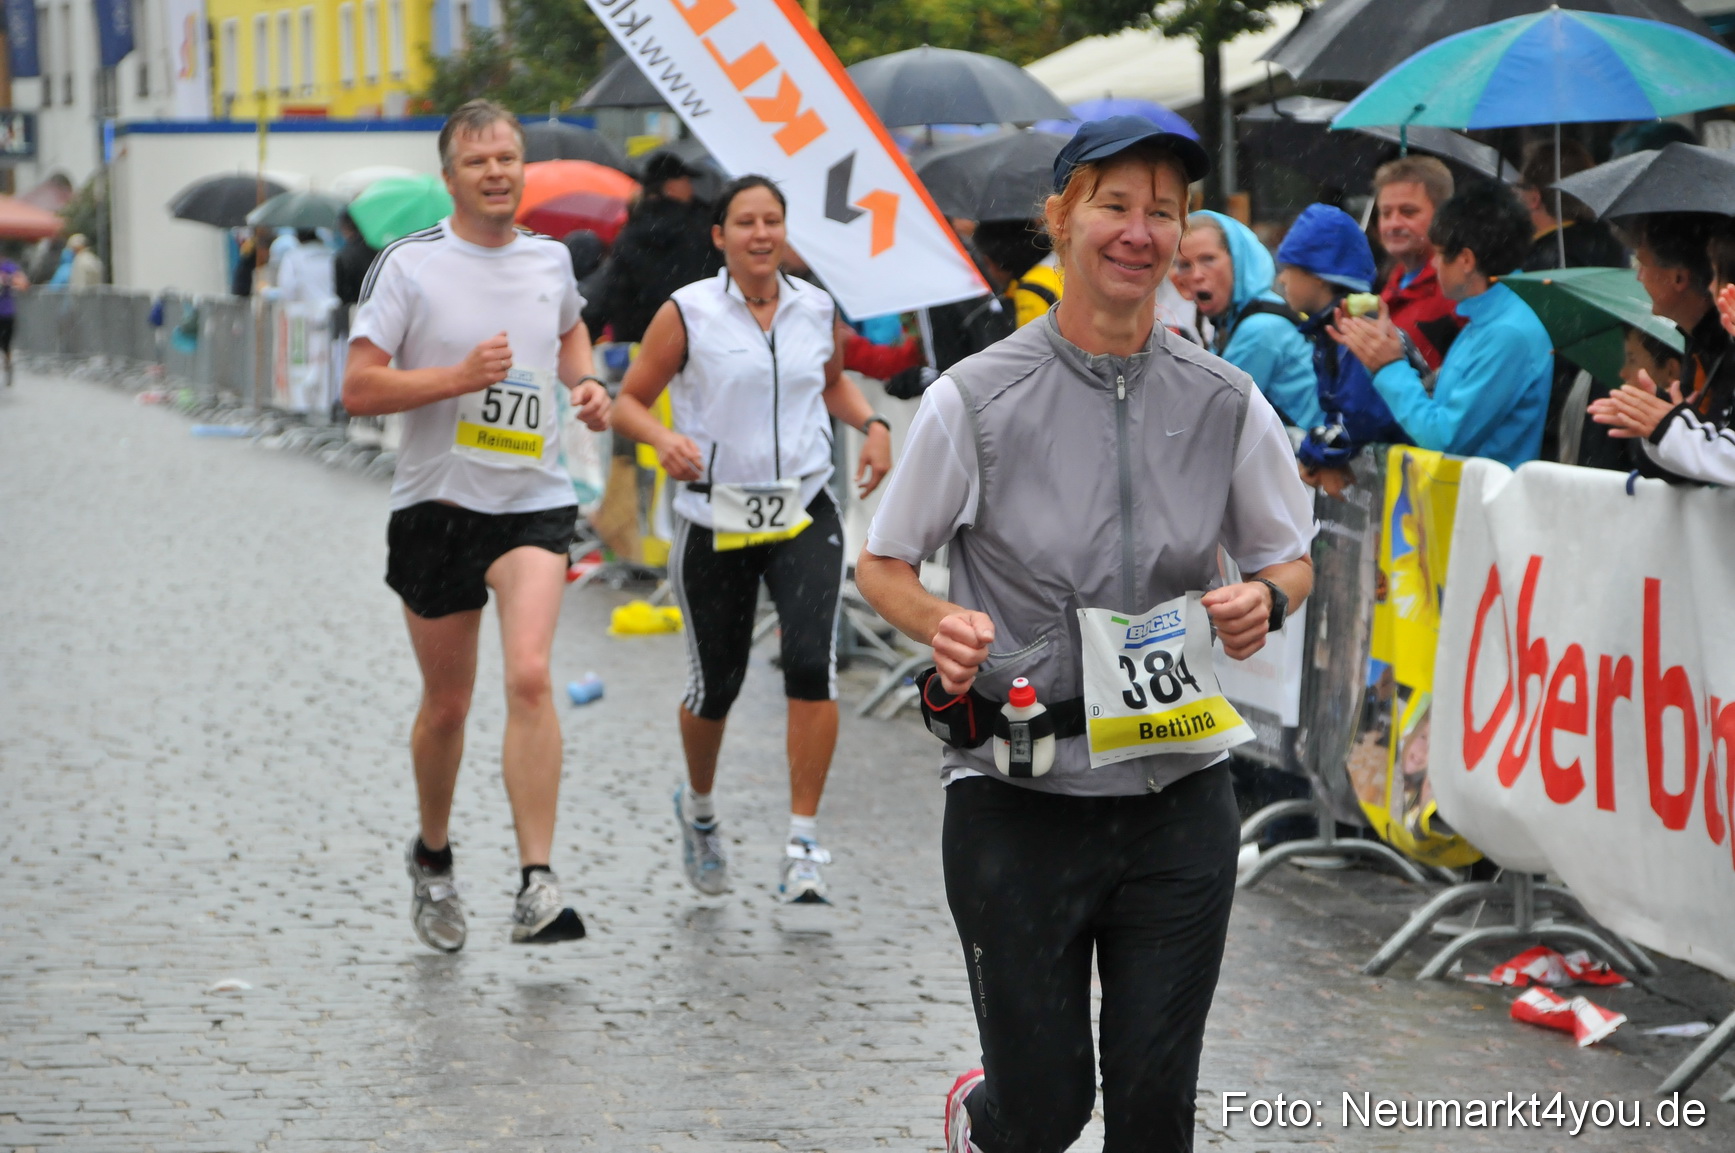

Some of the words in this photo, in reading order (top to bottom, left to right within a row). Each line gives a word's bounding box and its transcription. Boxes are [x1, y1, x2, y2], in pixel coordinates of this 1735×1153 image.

[481, 387, 540, 430] 570
[476, 430, 536, 453] Reimund
[746, 496, 785, 528] 32
[1119, 650, 1202, 709] 384
[1139, 711, 1216, 740] Bettina
